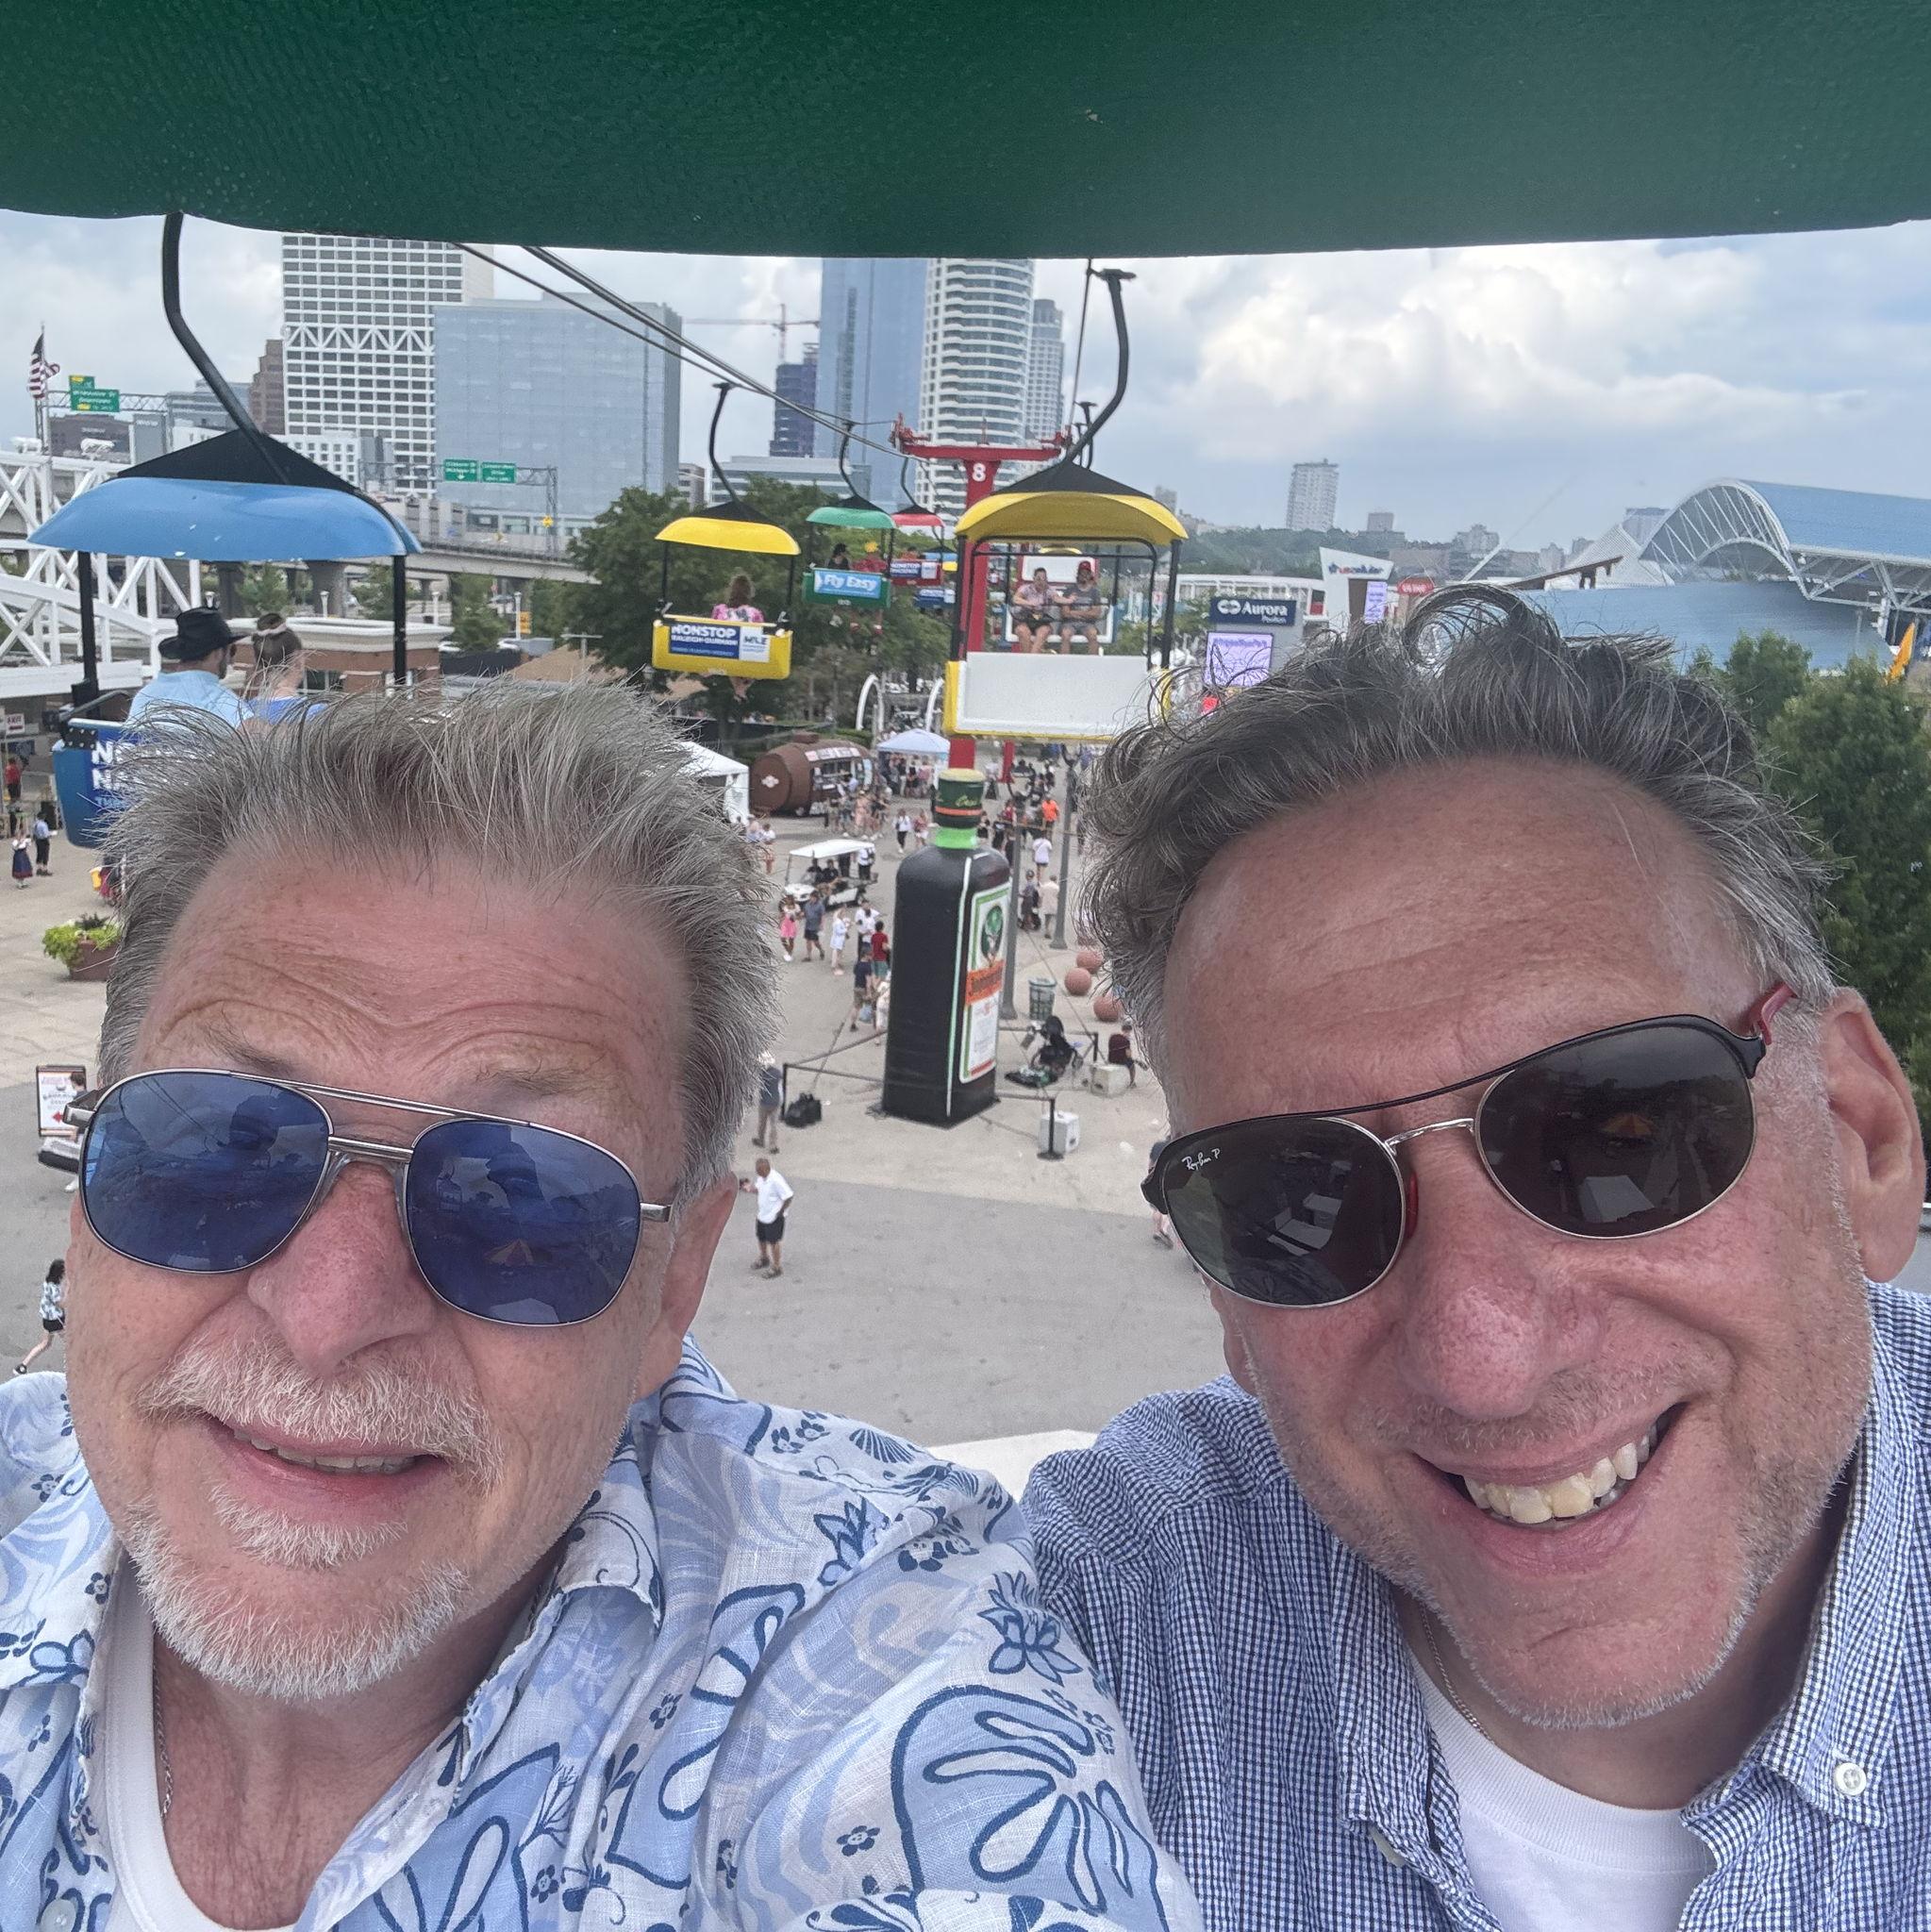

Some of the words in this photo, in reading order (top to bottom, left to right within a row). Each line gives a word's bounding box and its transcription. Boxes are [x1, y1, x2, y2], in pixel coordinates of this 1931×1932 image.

[972, 462, 987, 482] 8
[824, 574, 845, 589] Fly
[846, 575, 877, 591] Easy
[1241, 601, 1289, 617] Aurora
[671, 624, 737, 639] NONSTOP
[1211, 1147, 1221, 1159] P
